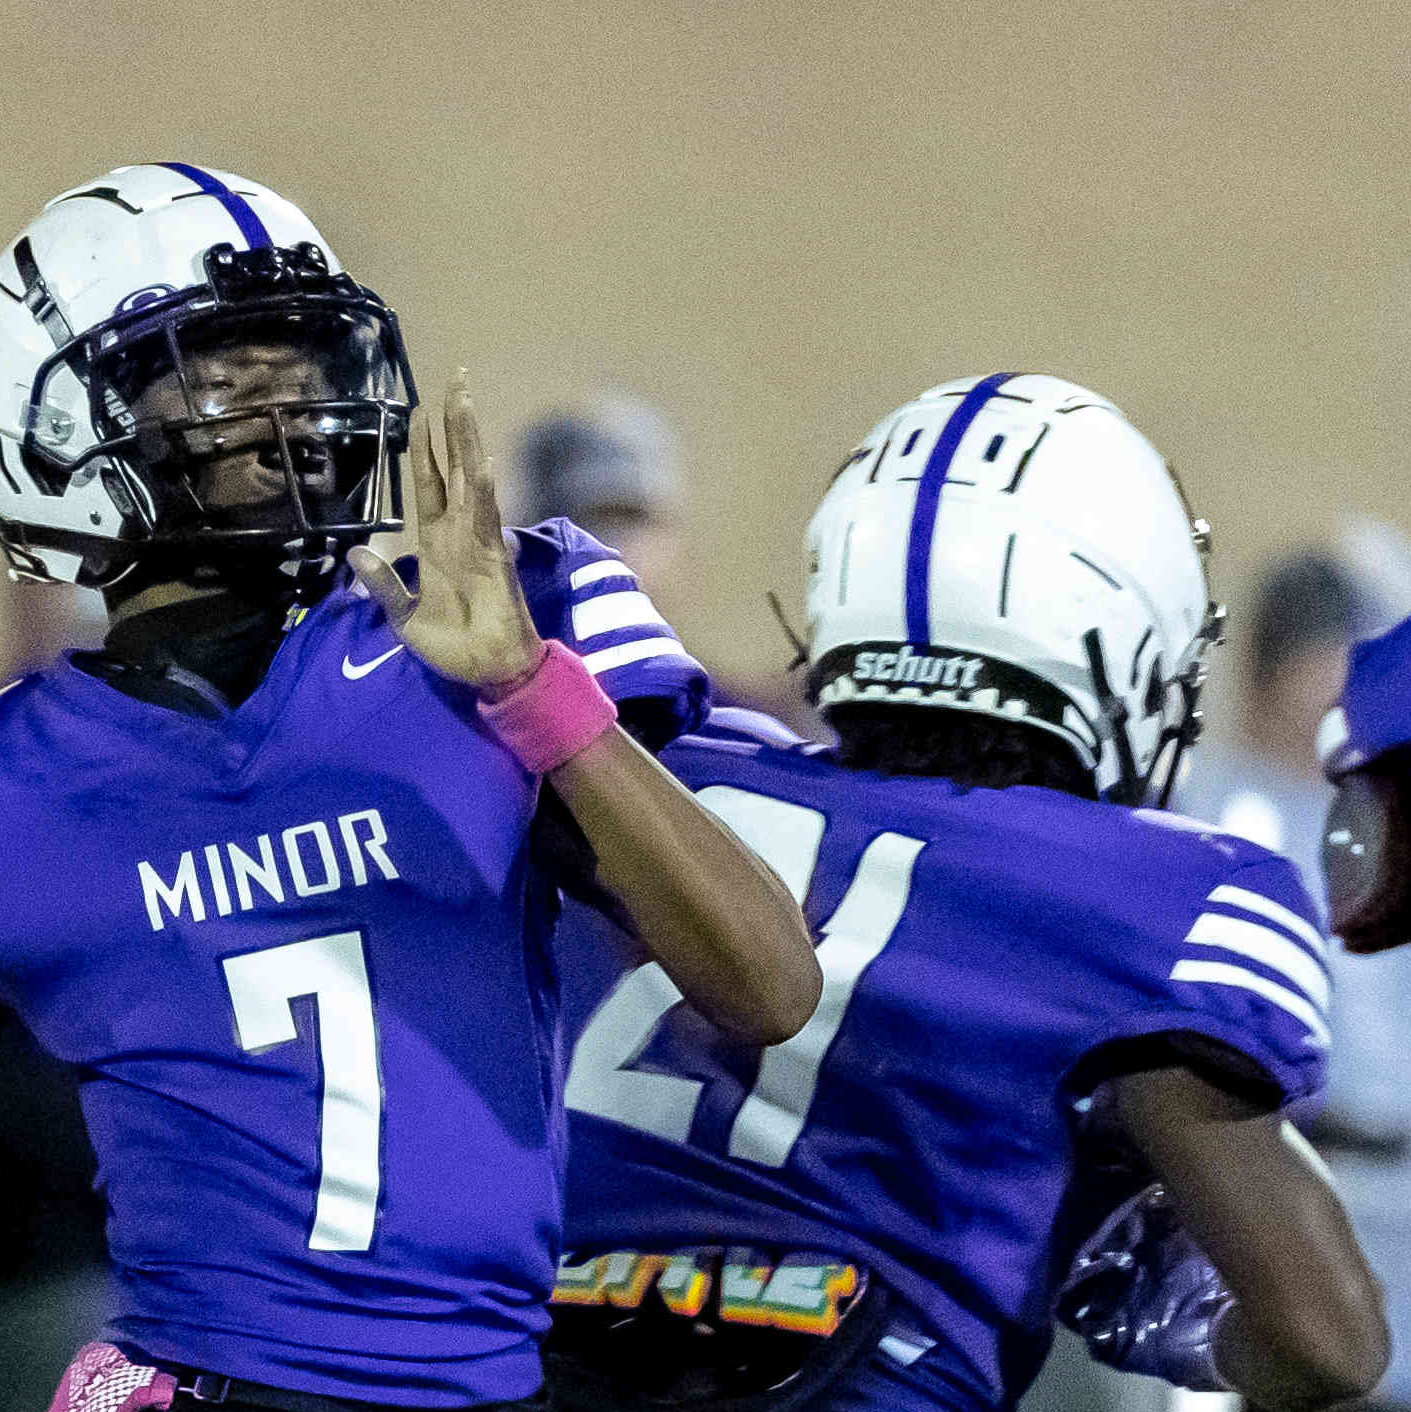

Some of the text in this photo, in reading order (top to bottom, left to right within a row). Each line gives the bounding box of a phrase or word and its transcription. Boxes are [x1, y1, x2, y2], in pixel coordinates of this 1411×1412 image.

[852, 645, 984, 688] schutt
[137, 808, 400, 931] MINOR
[222, 930, 386, 1252] 7
